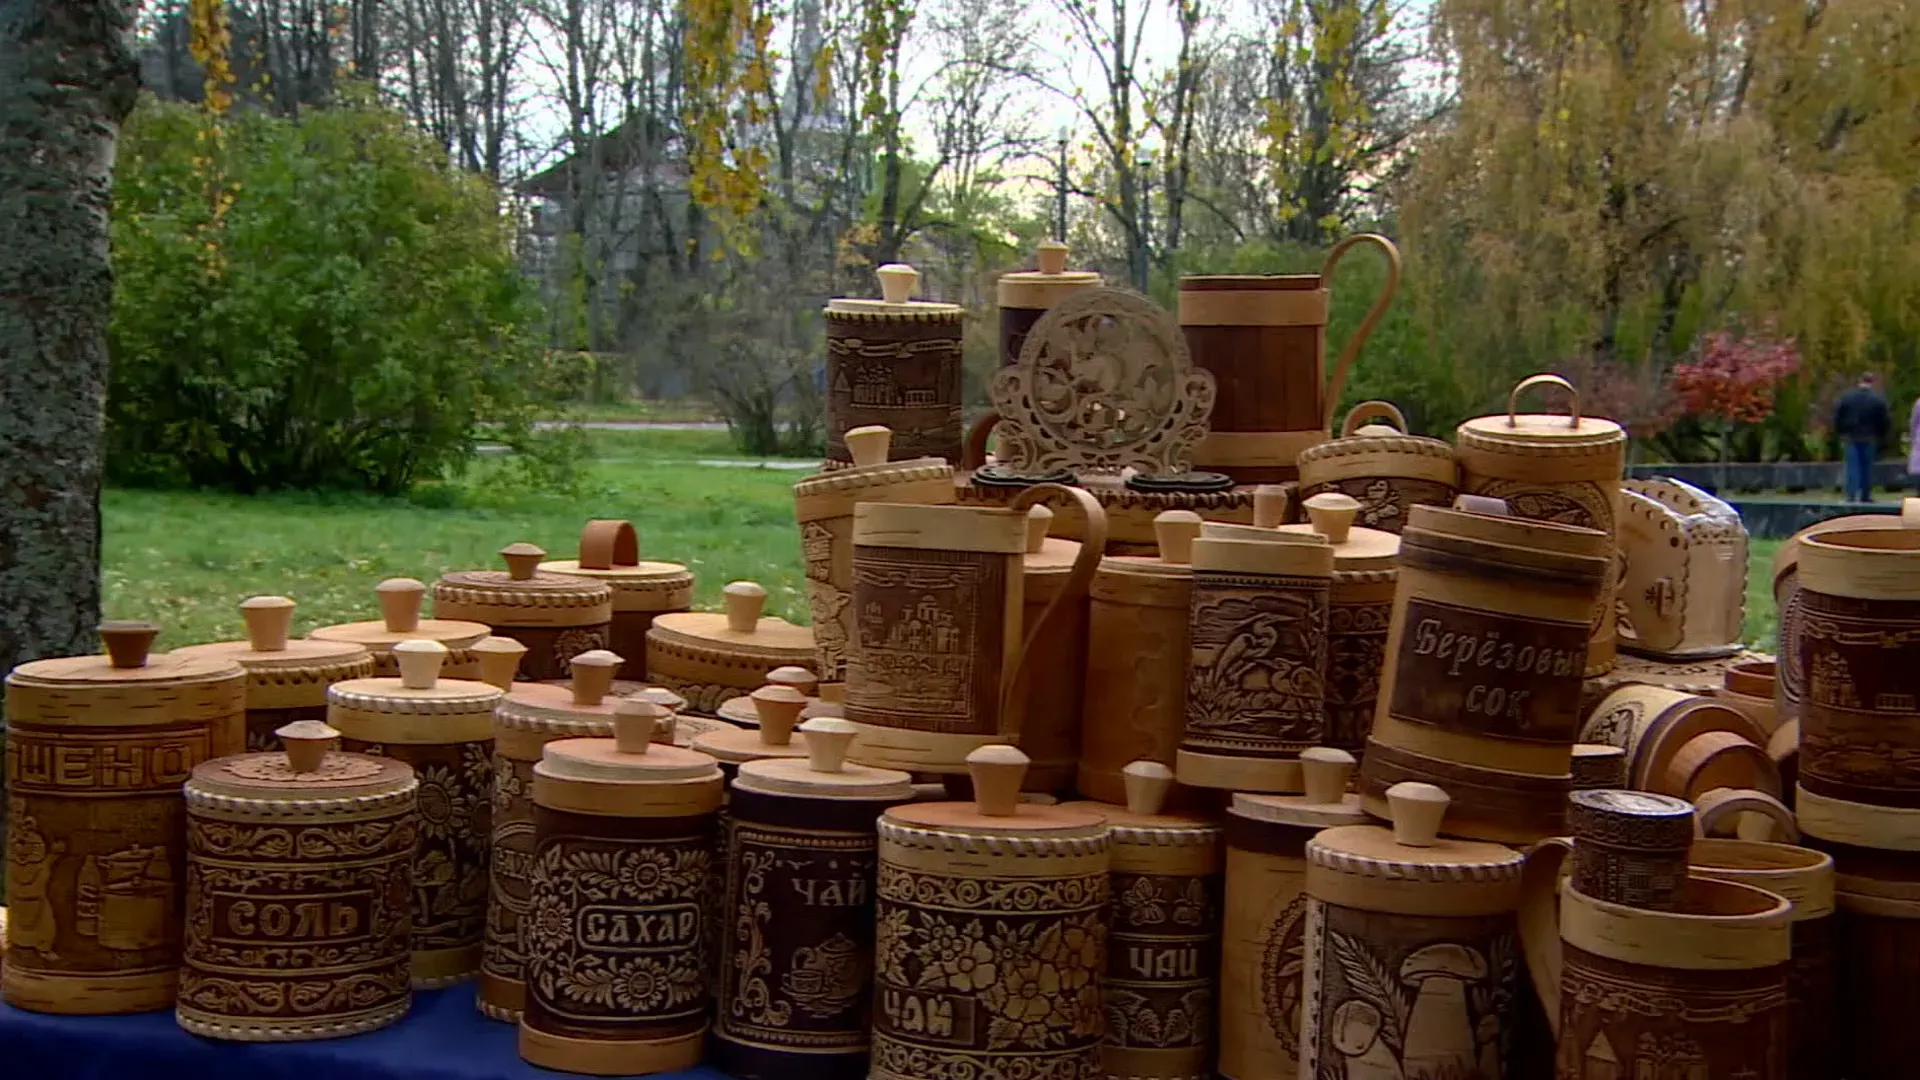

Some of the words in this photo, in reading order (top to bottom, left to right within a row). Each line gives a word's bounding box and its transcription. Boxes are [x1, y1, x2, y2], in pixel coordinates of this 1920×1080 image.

[790, 872, 867, 907] ЧАЙ
[227, 901, 358, 937] СОЛЬ
[585, 911, 694, 943] САХАР
